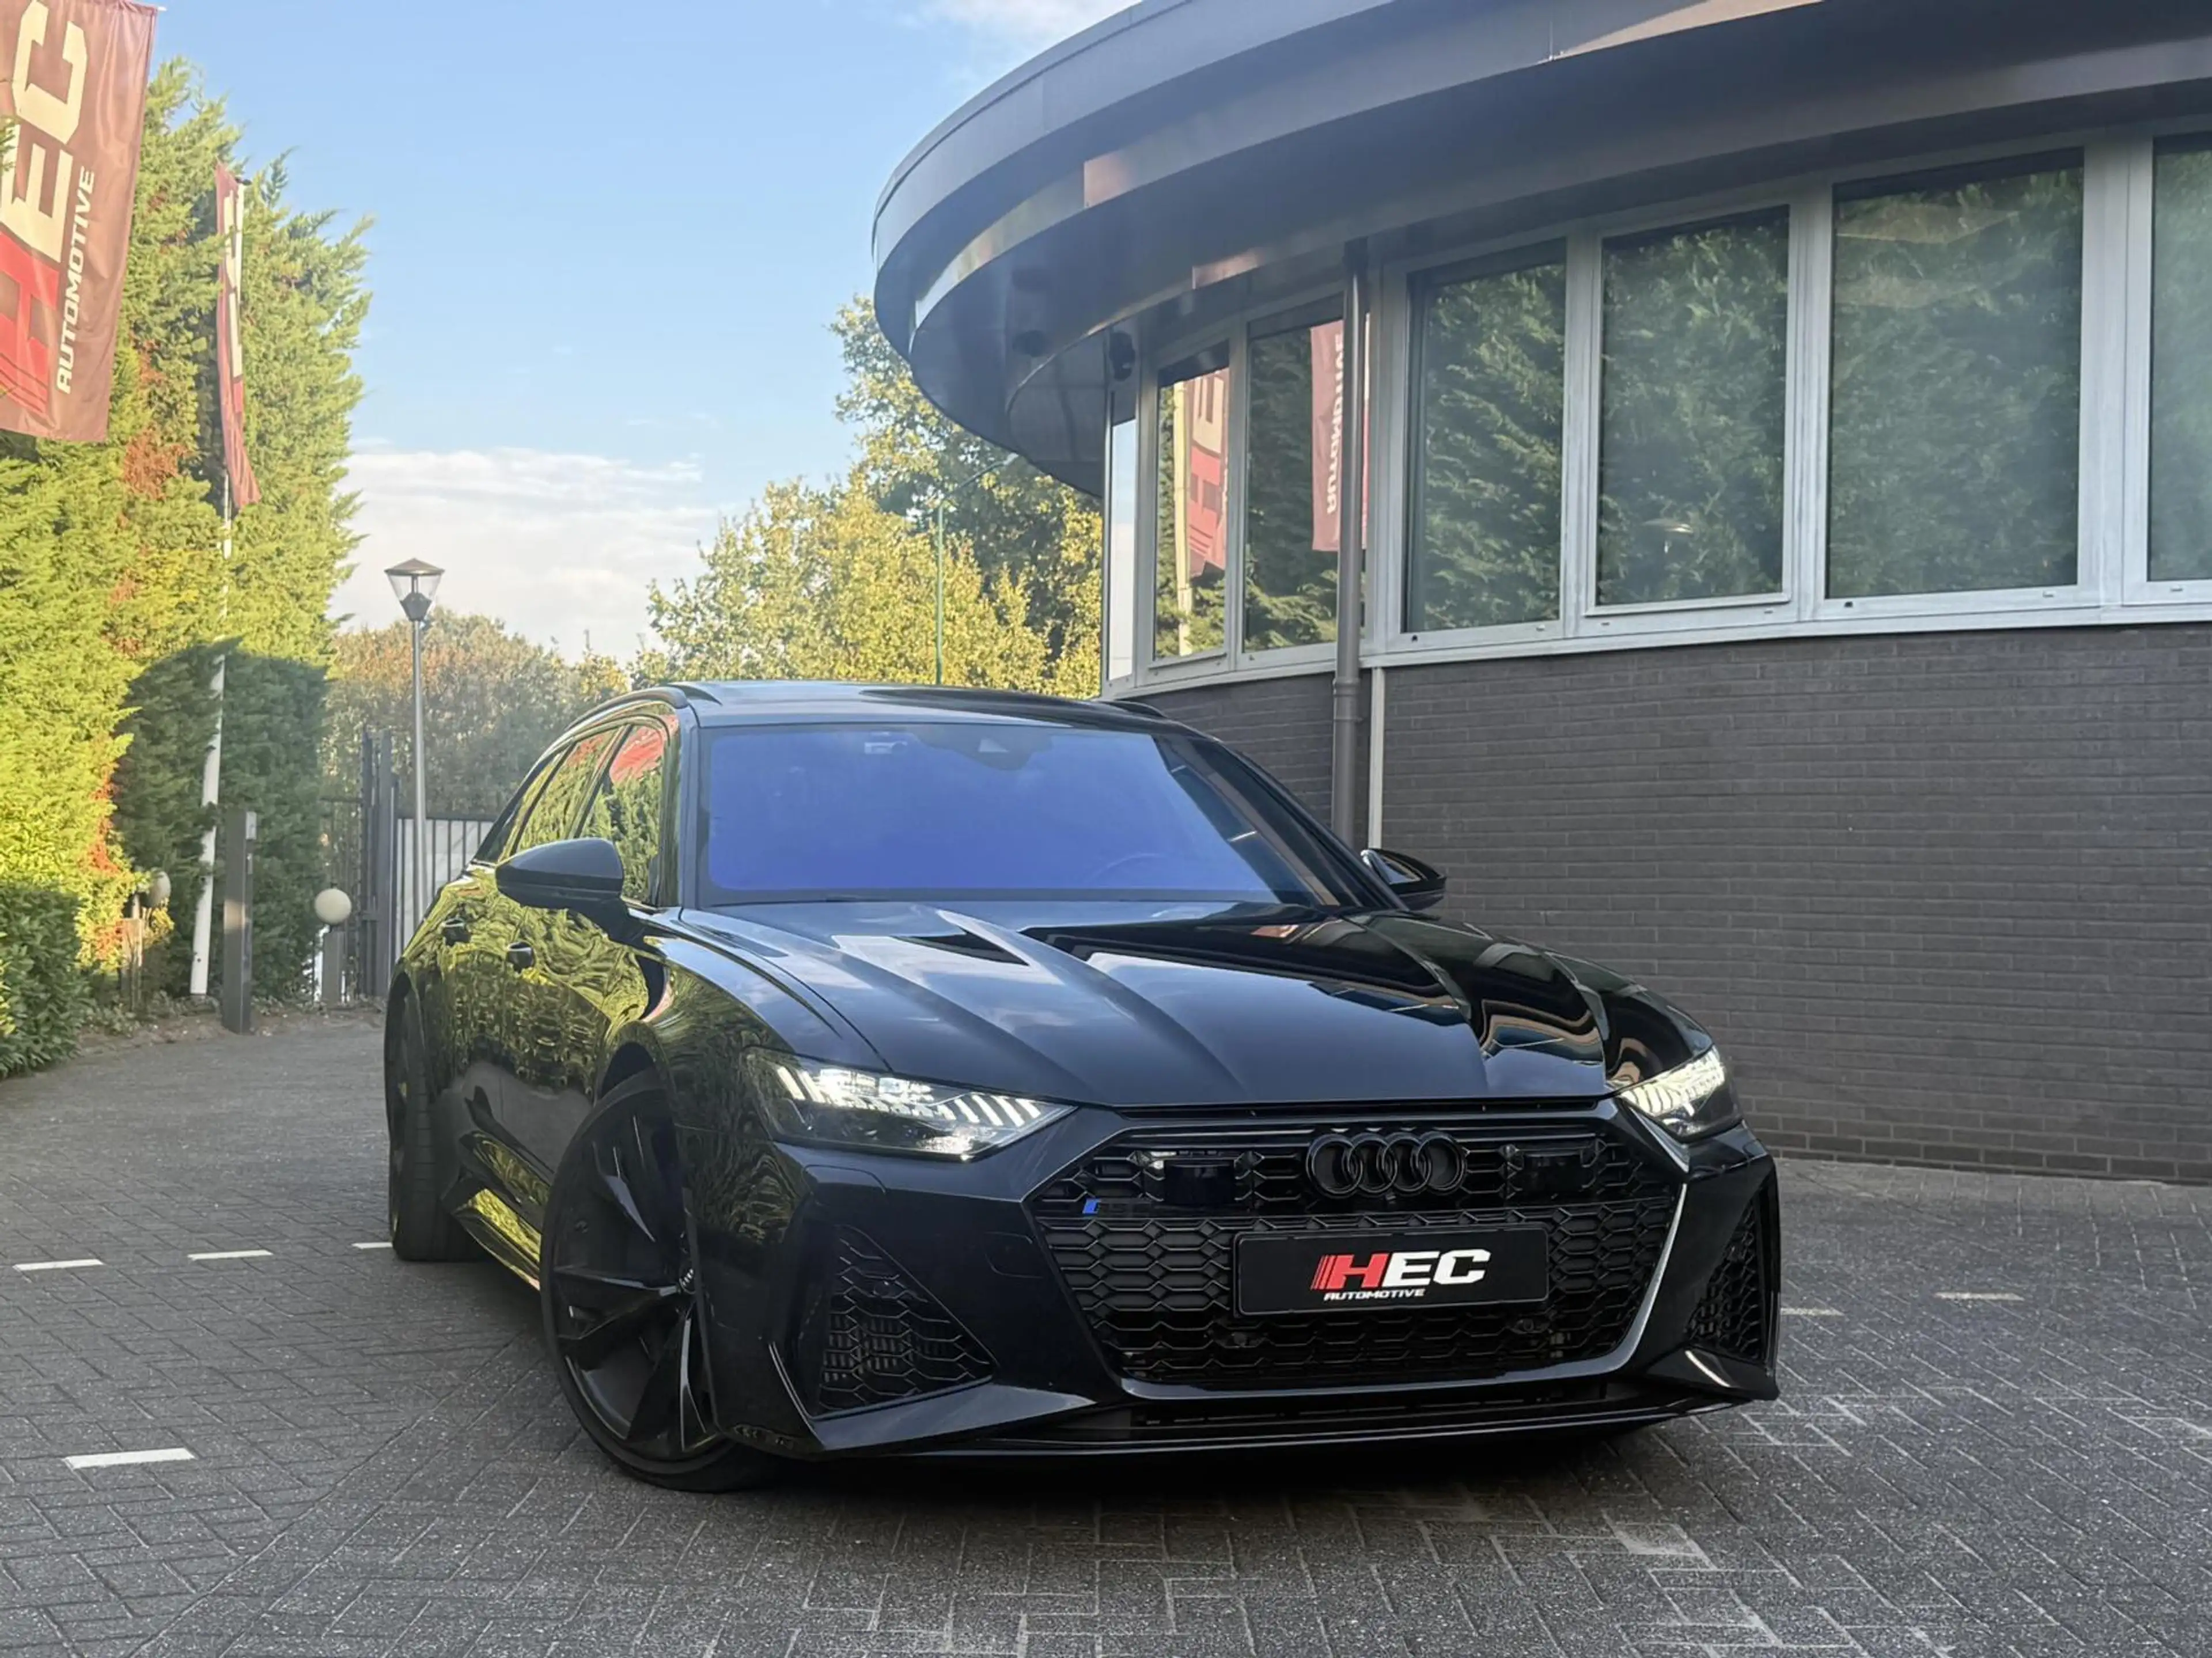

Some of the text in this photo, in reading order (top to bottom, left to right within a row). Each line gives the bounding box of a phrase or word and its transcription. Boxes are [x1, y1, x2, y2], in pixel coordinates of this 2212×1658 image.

[0, 0, 87, 415] HEC
[56, 166, 94, 394] AUTOMOTIVE
[1311, 1249, 1491, 1290] HEC
[1324, 1288, 1425, 1301] AUTOMOTIVE
